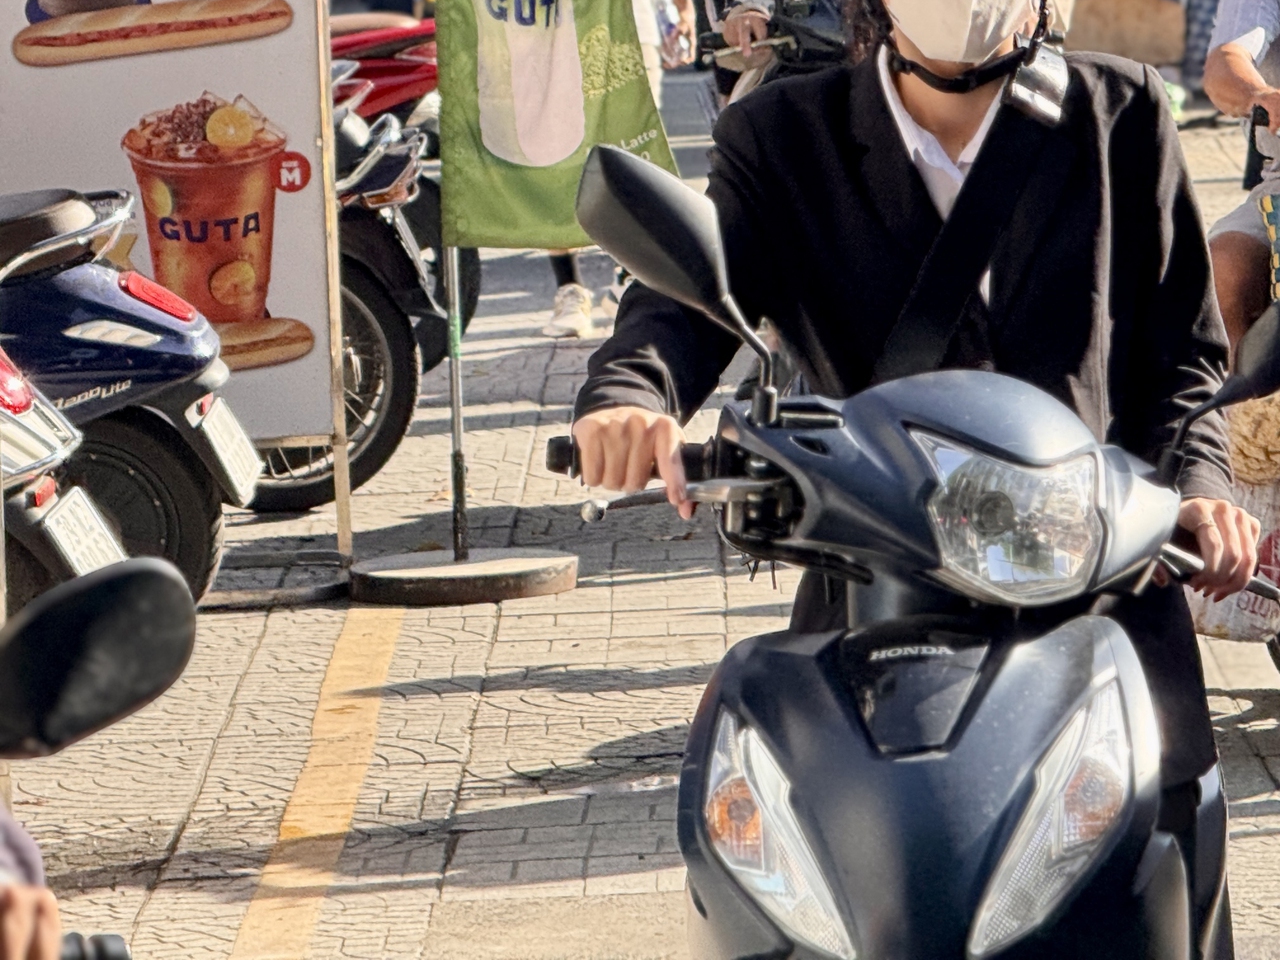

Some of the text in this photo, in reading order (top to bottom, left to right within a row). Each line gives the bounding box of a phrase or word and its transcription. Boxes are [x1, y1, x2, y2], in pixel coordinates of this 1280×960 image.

[620, 129, 658, 150] Latte
[280, 168, 301, 186] M
[159, 211, 260, 243] GUTA
[869, 646, 955, 660] HONDA
